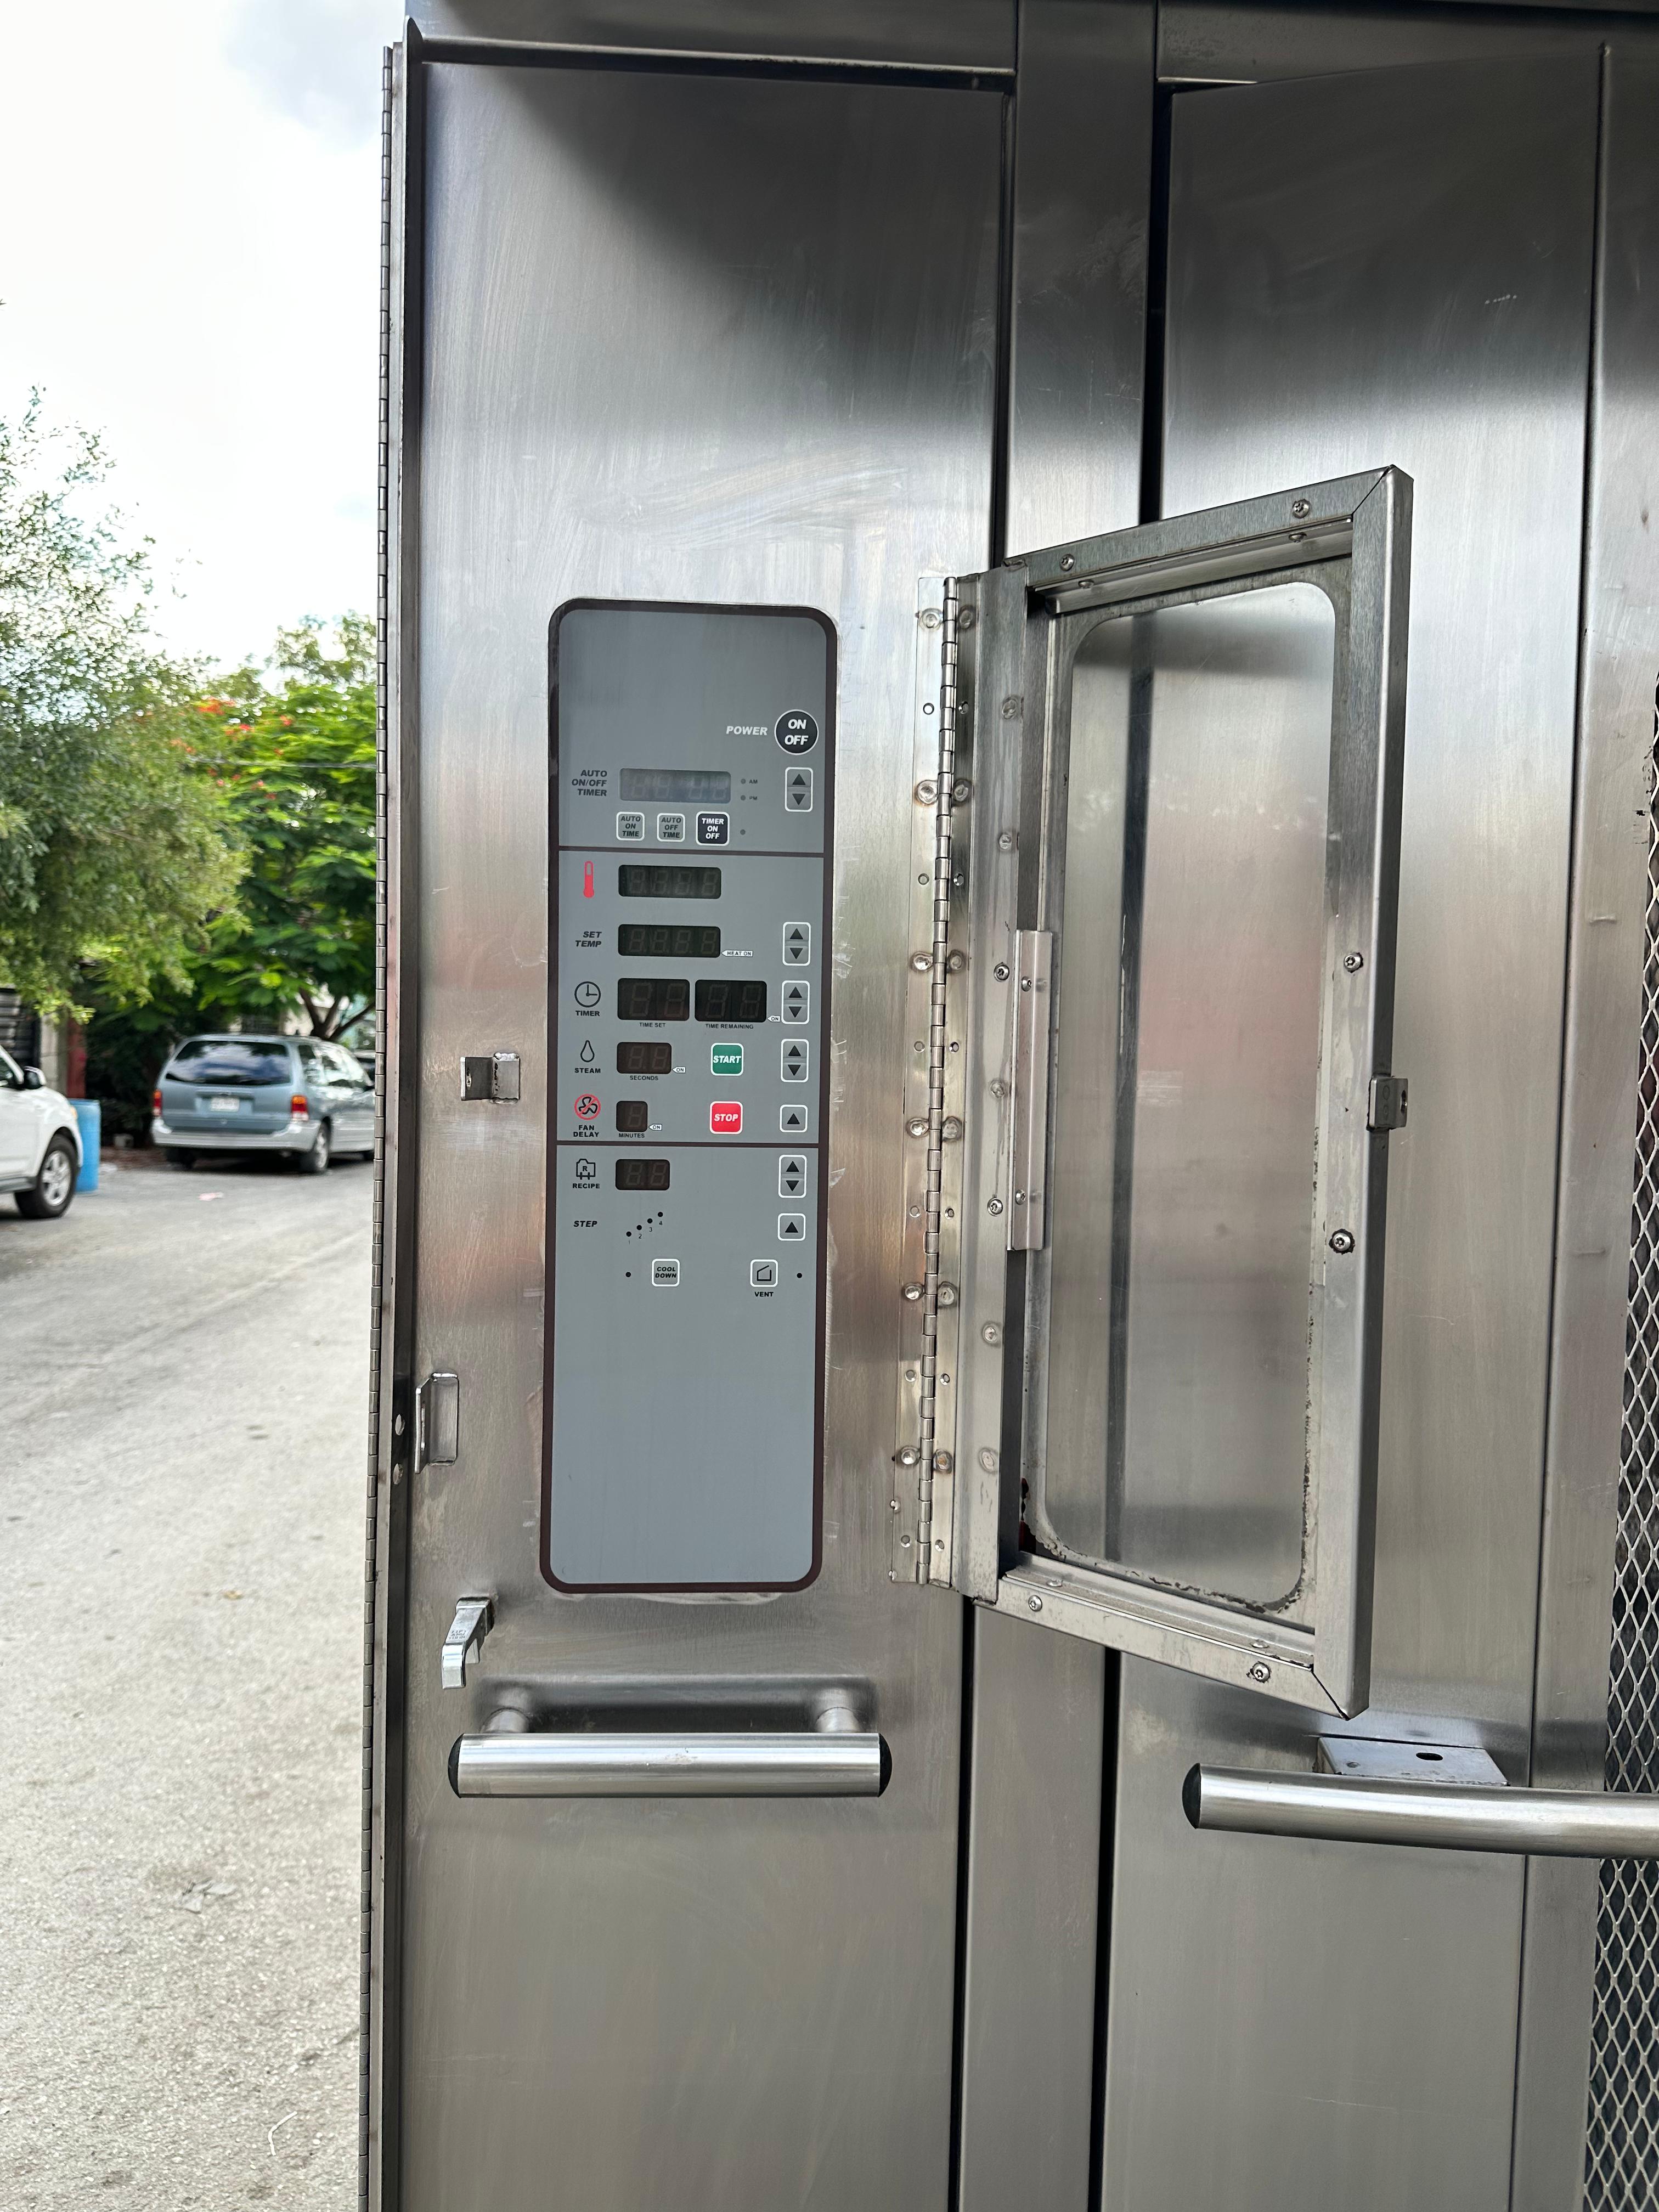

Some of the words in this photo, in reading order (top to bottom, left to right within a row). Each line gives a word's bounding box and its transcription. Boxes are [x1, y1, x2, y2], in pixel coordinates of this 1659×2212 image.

[788, 719, 807, 730] ON
[726, 726, 768, 736] POWER
[785, 735, 809, 746] OFF
[571, 778, 607, 787] ON/OFF
[577, 788, 607, 797] TIMER
[713, 1055, 742, 1064] START
[714, 1113, 738, 1122] STOP
